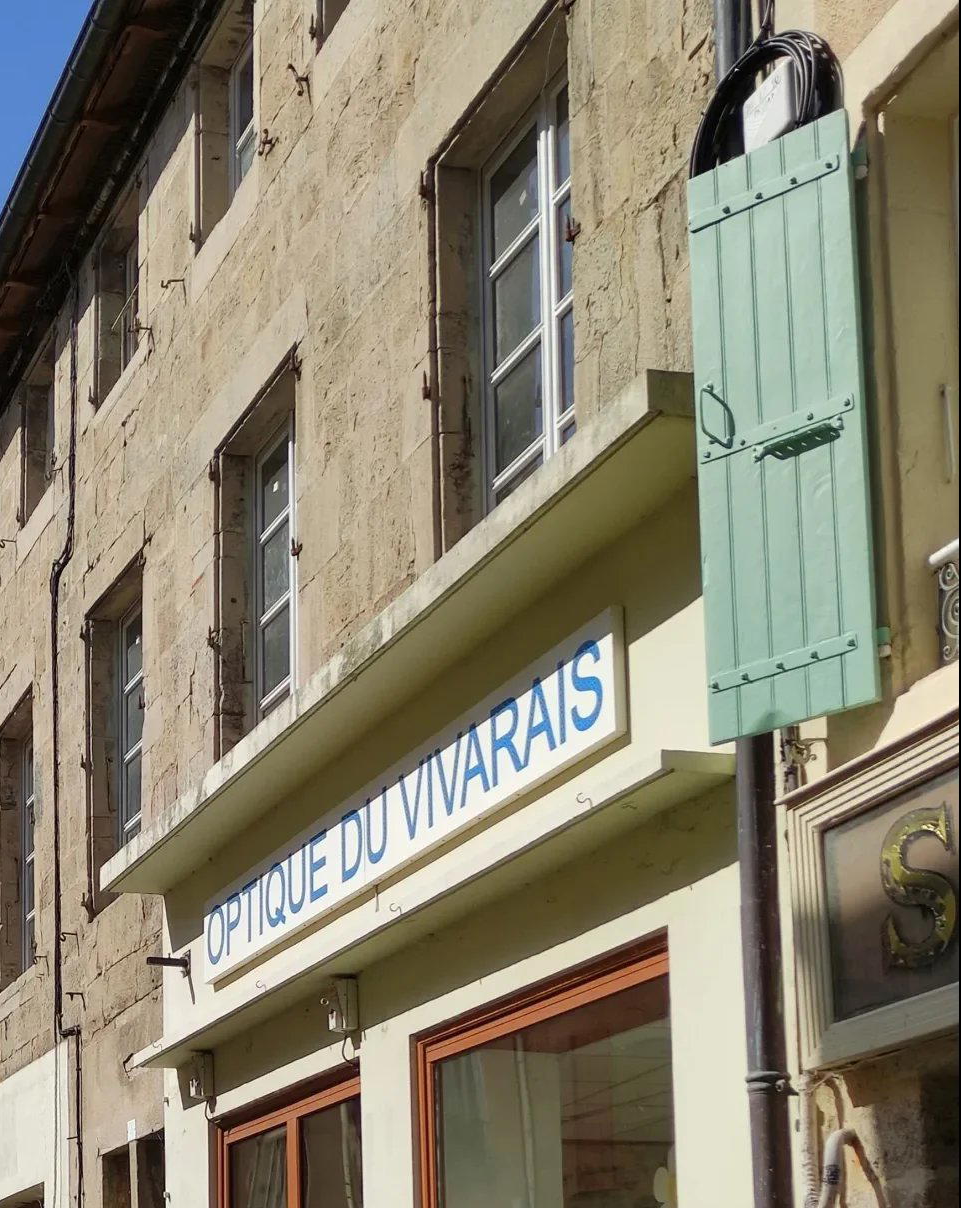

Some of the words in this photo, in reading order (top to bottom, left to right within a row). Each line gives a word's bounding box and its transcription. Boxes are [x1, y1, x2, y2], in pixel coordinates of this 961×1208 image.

[207, 828, 329, 966] OPTIQUE
[340, 785, 388, 884] DU
[398, 639, 604, 841] VIVARAIS
[880, 801, 957, 975] S
